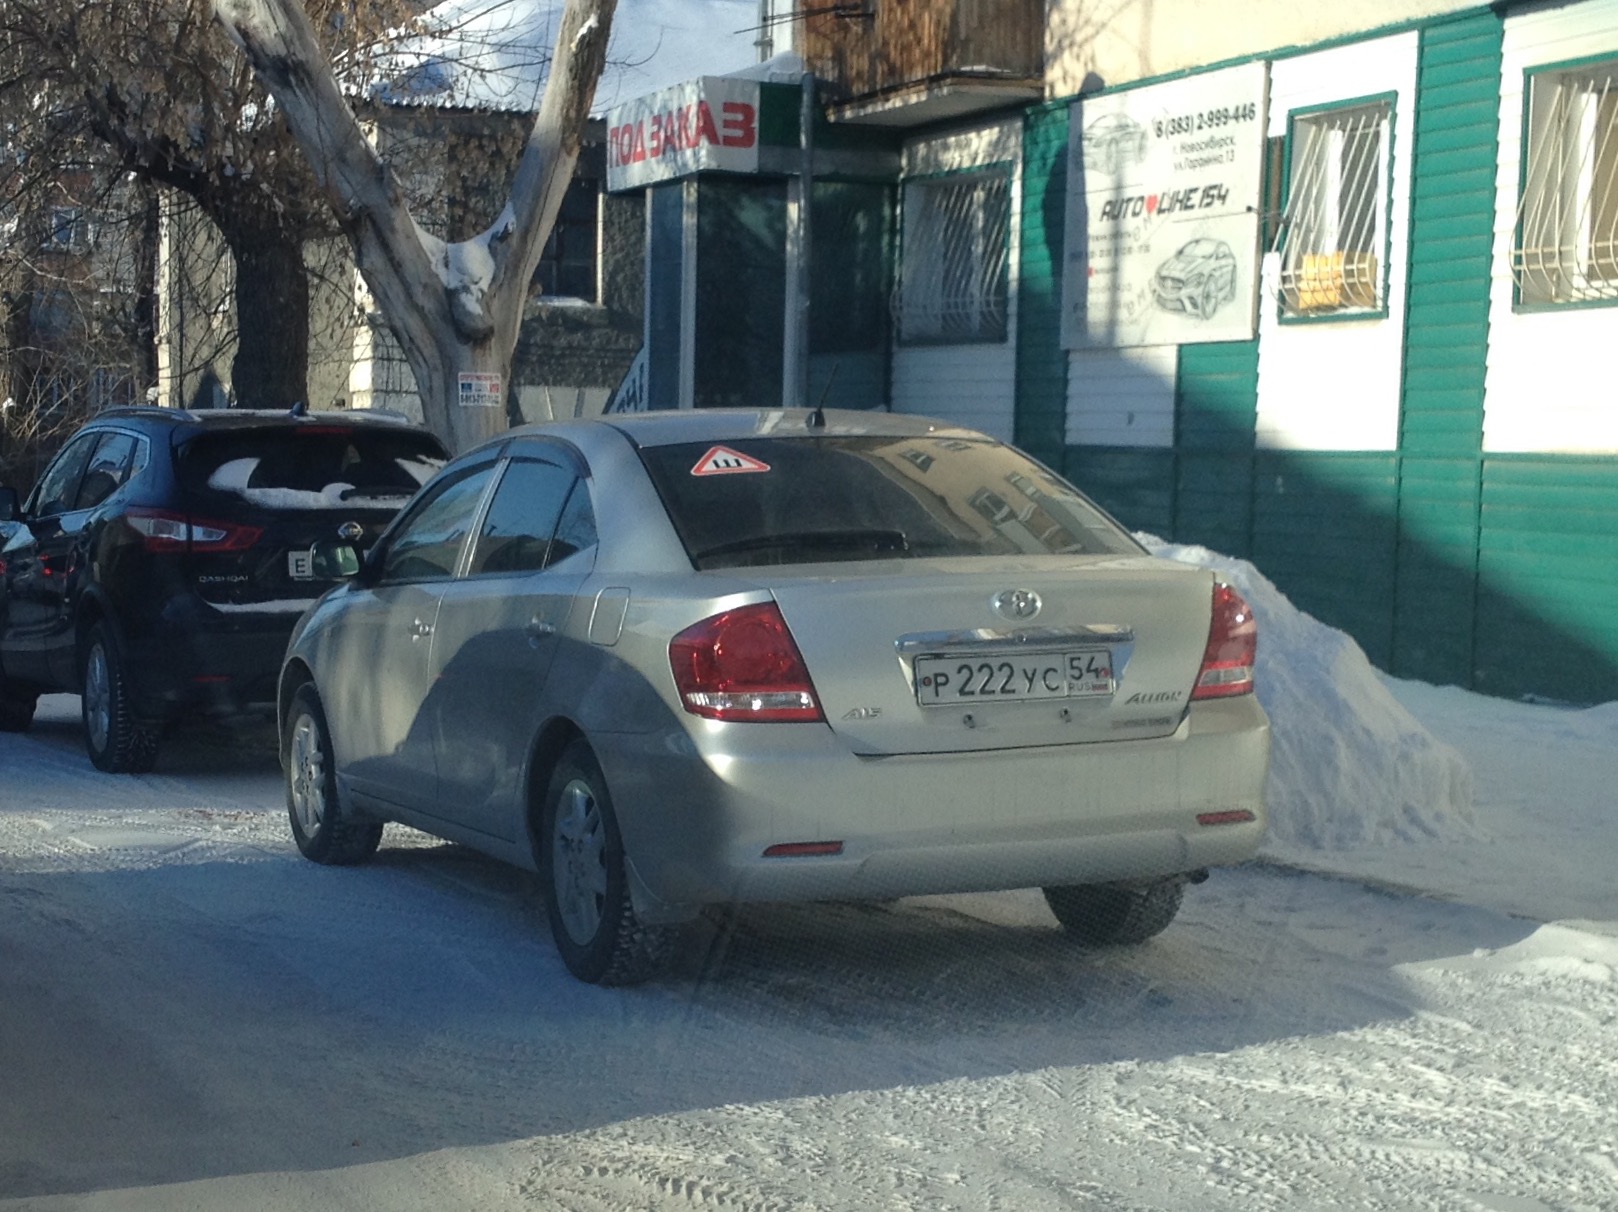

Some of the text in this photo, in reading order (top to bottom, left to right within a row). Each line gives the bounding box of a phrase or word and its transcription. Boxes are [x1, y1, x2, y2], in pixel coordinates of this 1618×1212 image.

[1156, 101, 1255, 140] 8 (383) 2-999-446
[609, 99, 756, 169] ПОД ЗАКАЗ
[1099, 194, 1145, 222] AUTO
[199, 575, 249, 583] QASHQAI
[1069, 656, 1100, 681] 54
[1068, 682, 1091, 692] RUS
